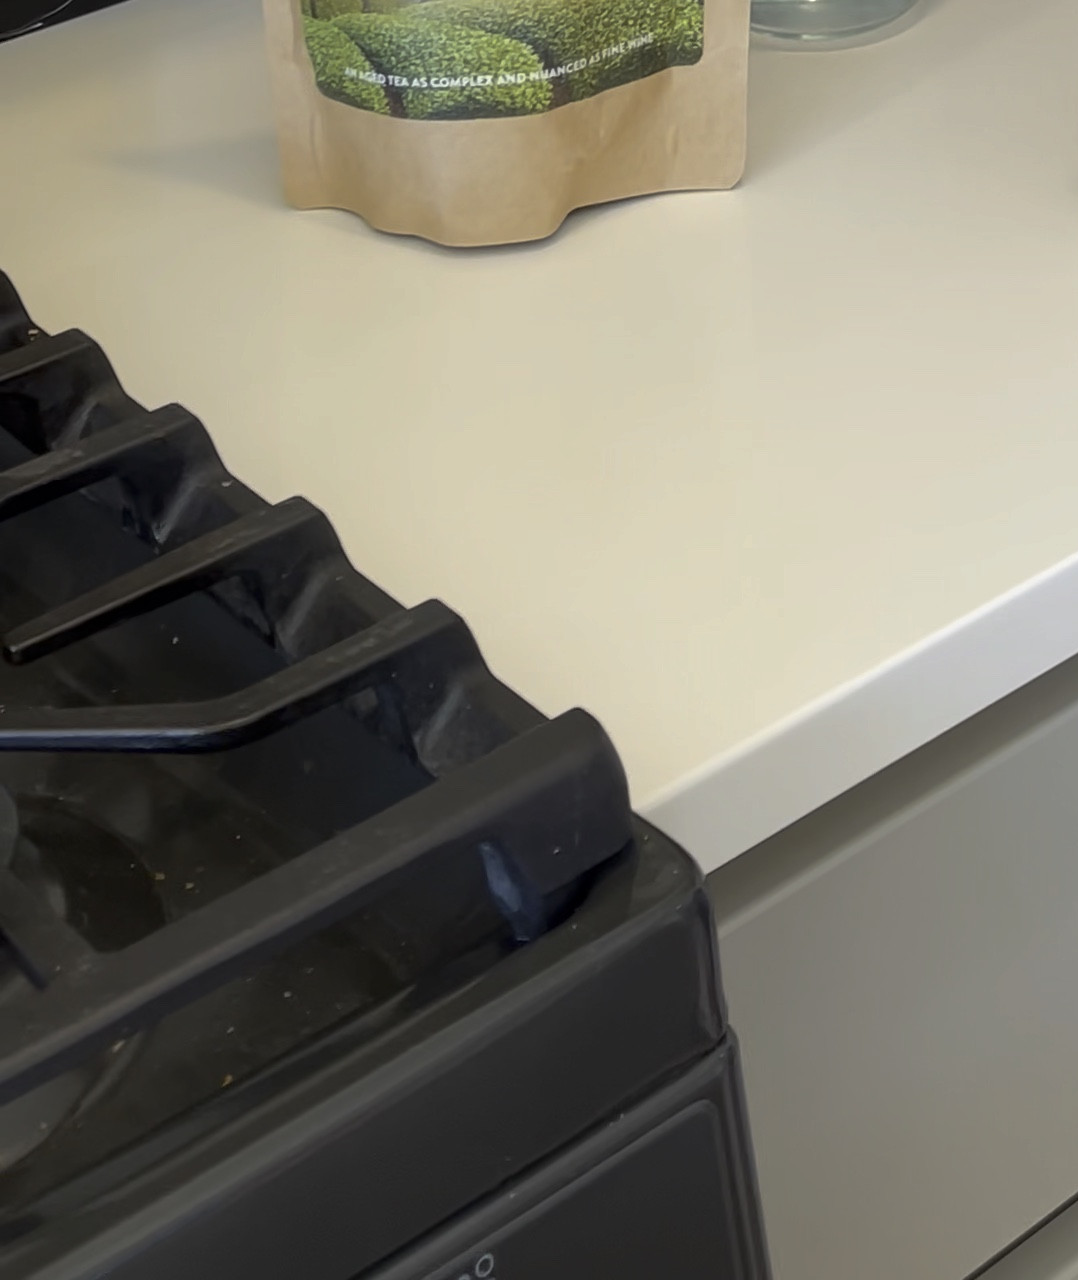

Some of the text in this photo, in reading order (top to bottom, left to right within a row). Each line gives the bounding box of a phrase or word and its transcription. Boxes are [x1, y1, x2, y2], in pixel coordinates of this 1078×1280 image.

[388, 75, 409, 87] TEA
[411, 76, 428, 88] AS
[430, 75, 493, 88] COMPLEX
[497, 72, 526, 85] AND
[589, 53, 601, 65] AS
[602, 45, 625, 59] FINE
